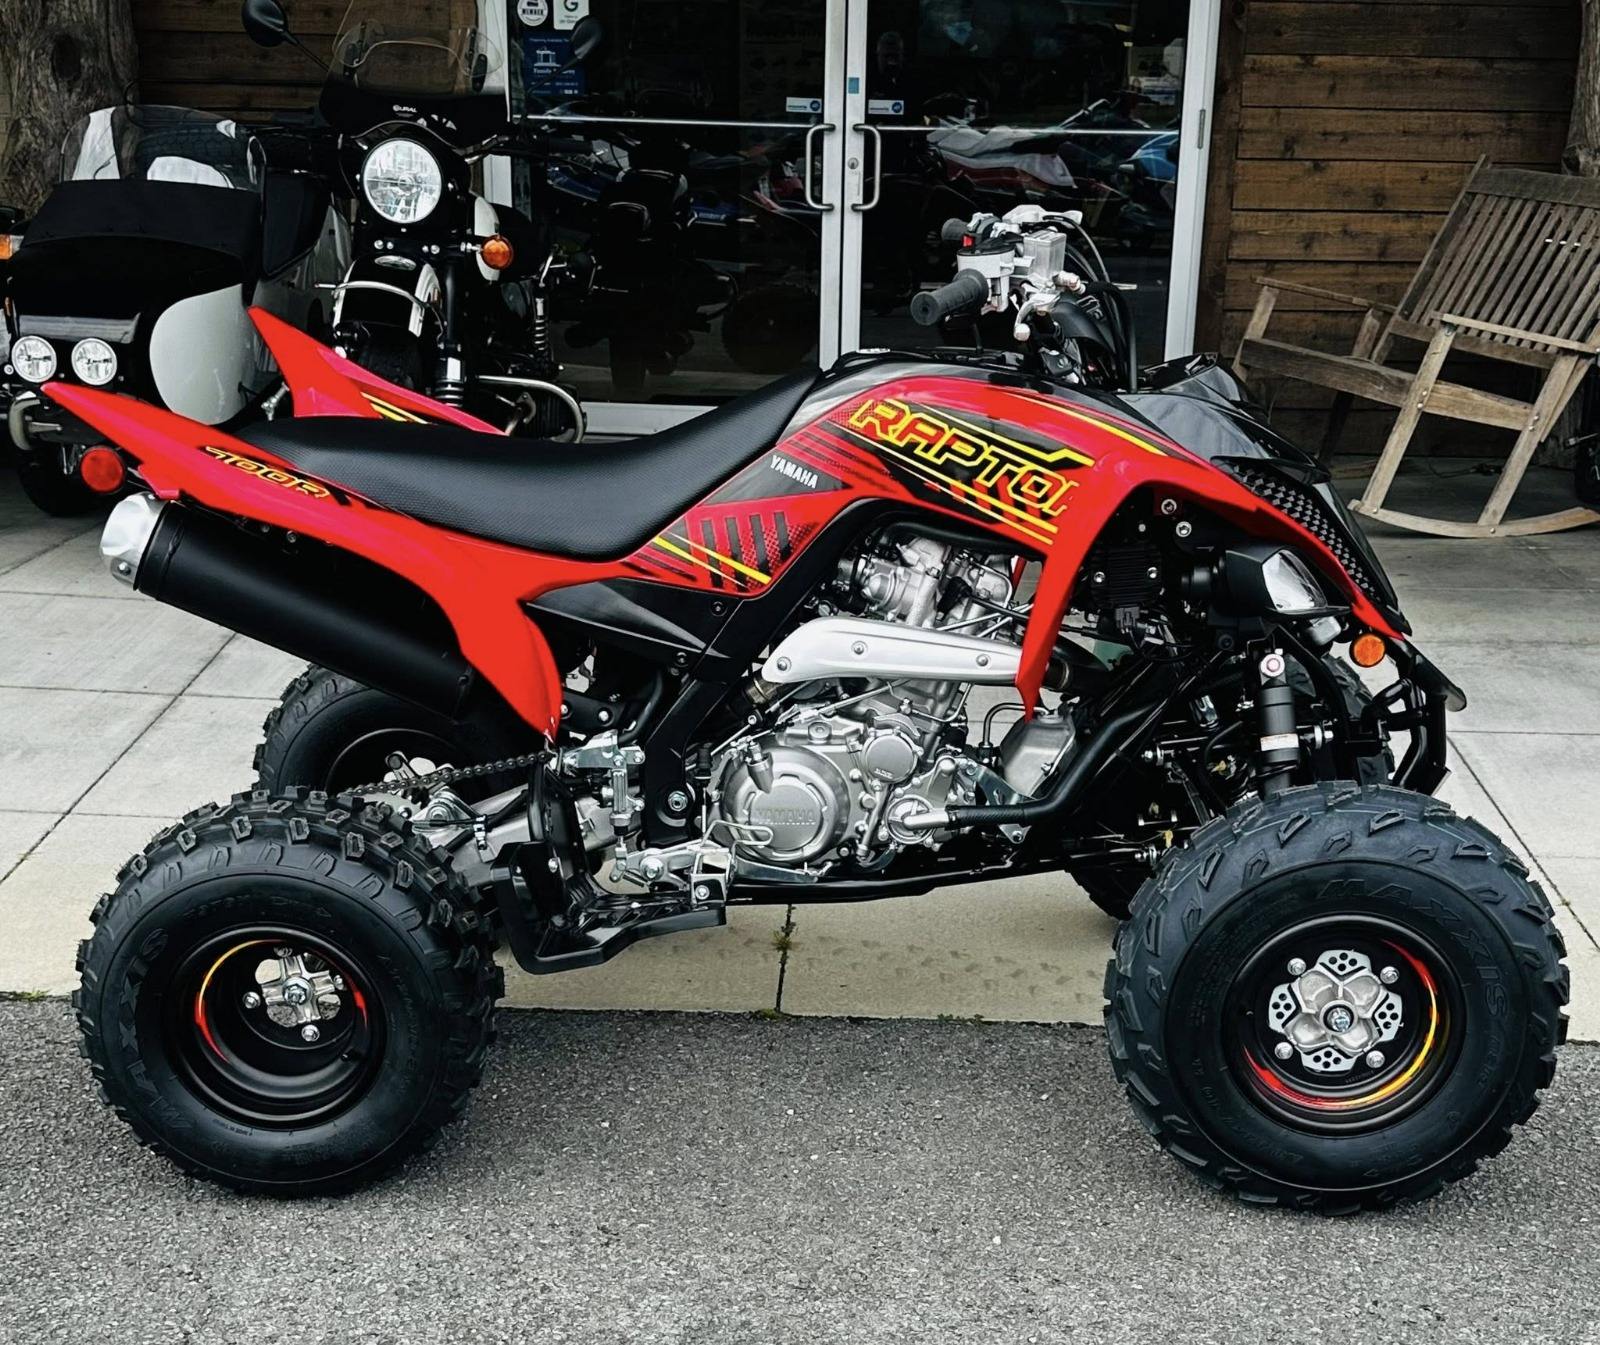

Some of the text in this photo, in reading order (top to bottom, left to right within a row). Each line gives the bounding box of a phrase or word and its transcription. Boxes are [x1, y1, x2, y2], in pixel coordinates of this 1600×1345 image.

[204, 445, 331, 499] 700R
[770, 455, 819, 489] YAMAHA
[1316, 878, 1509, 1017] MAXXIS
[118, 928, 193, 1129] MAXXIS
